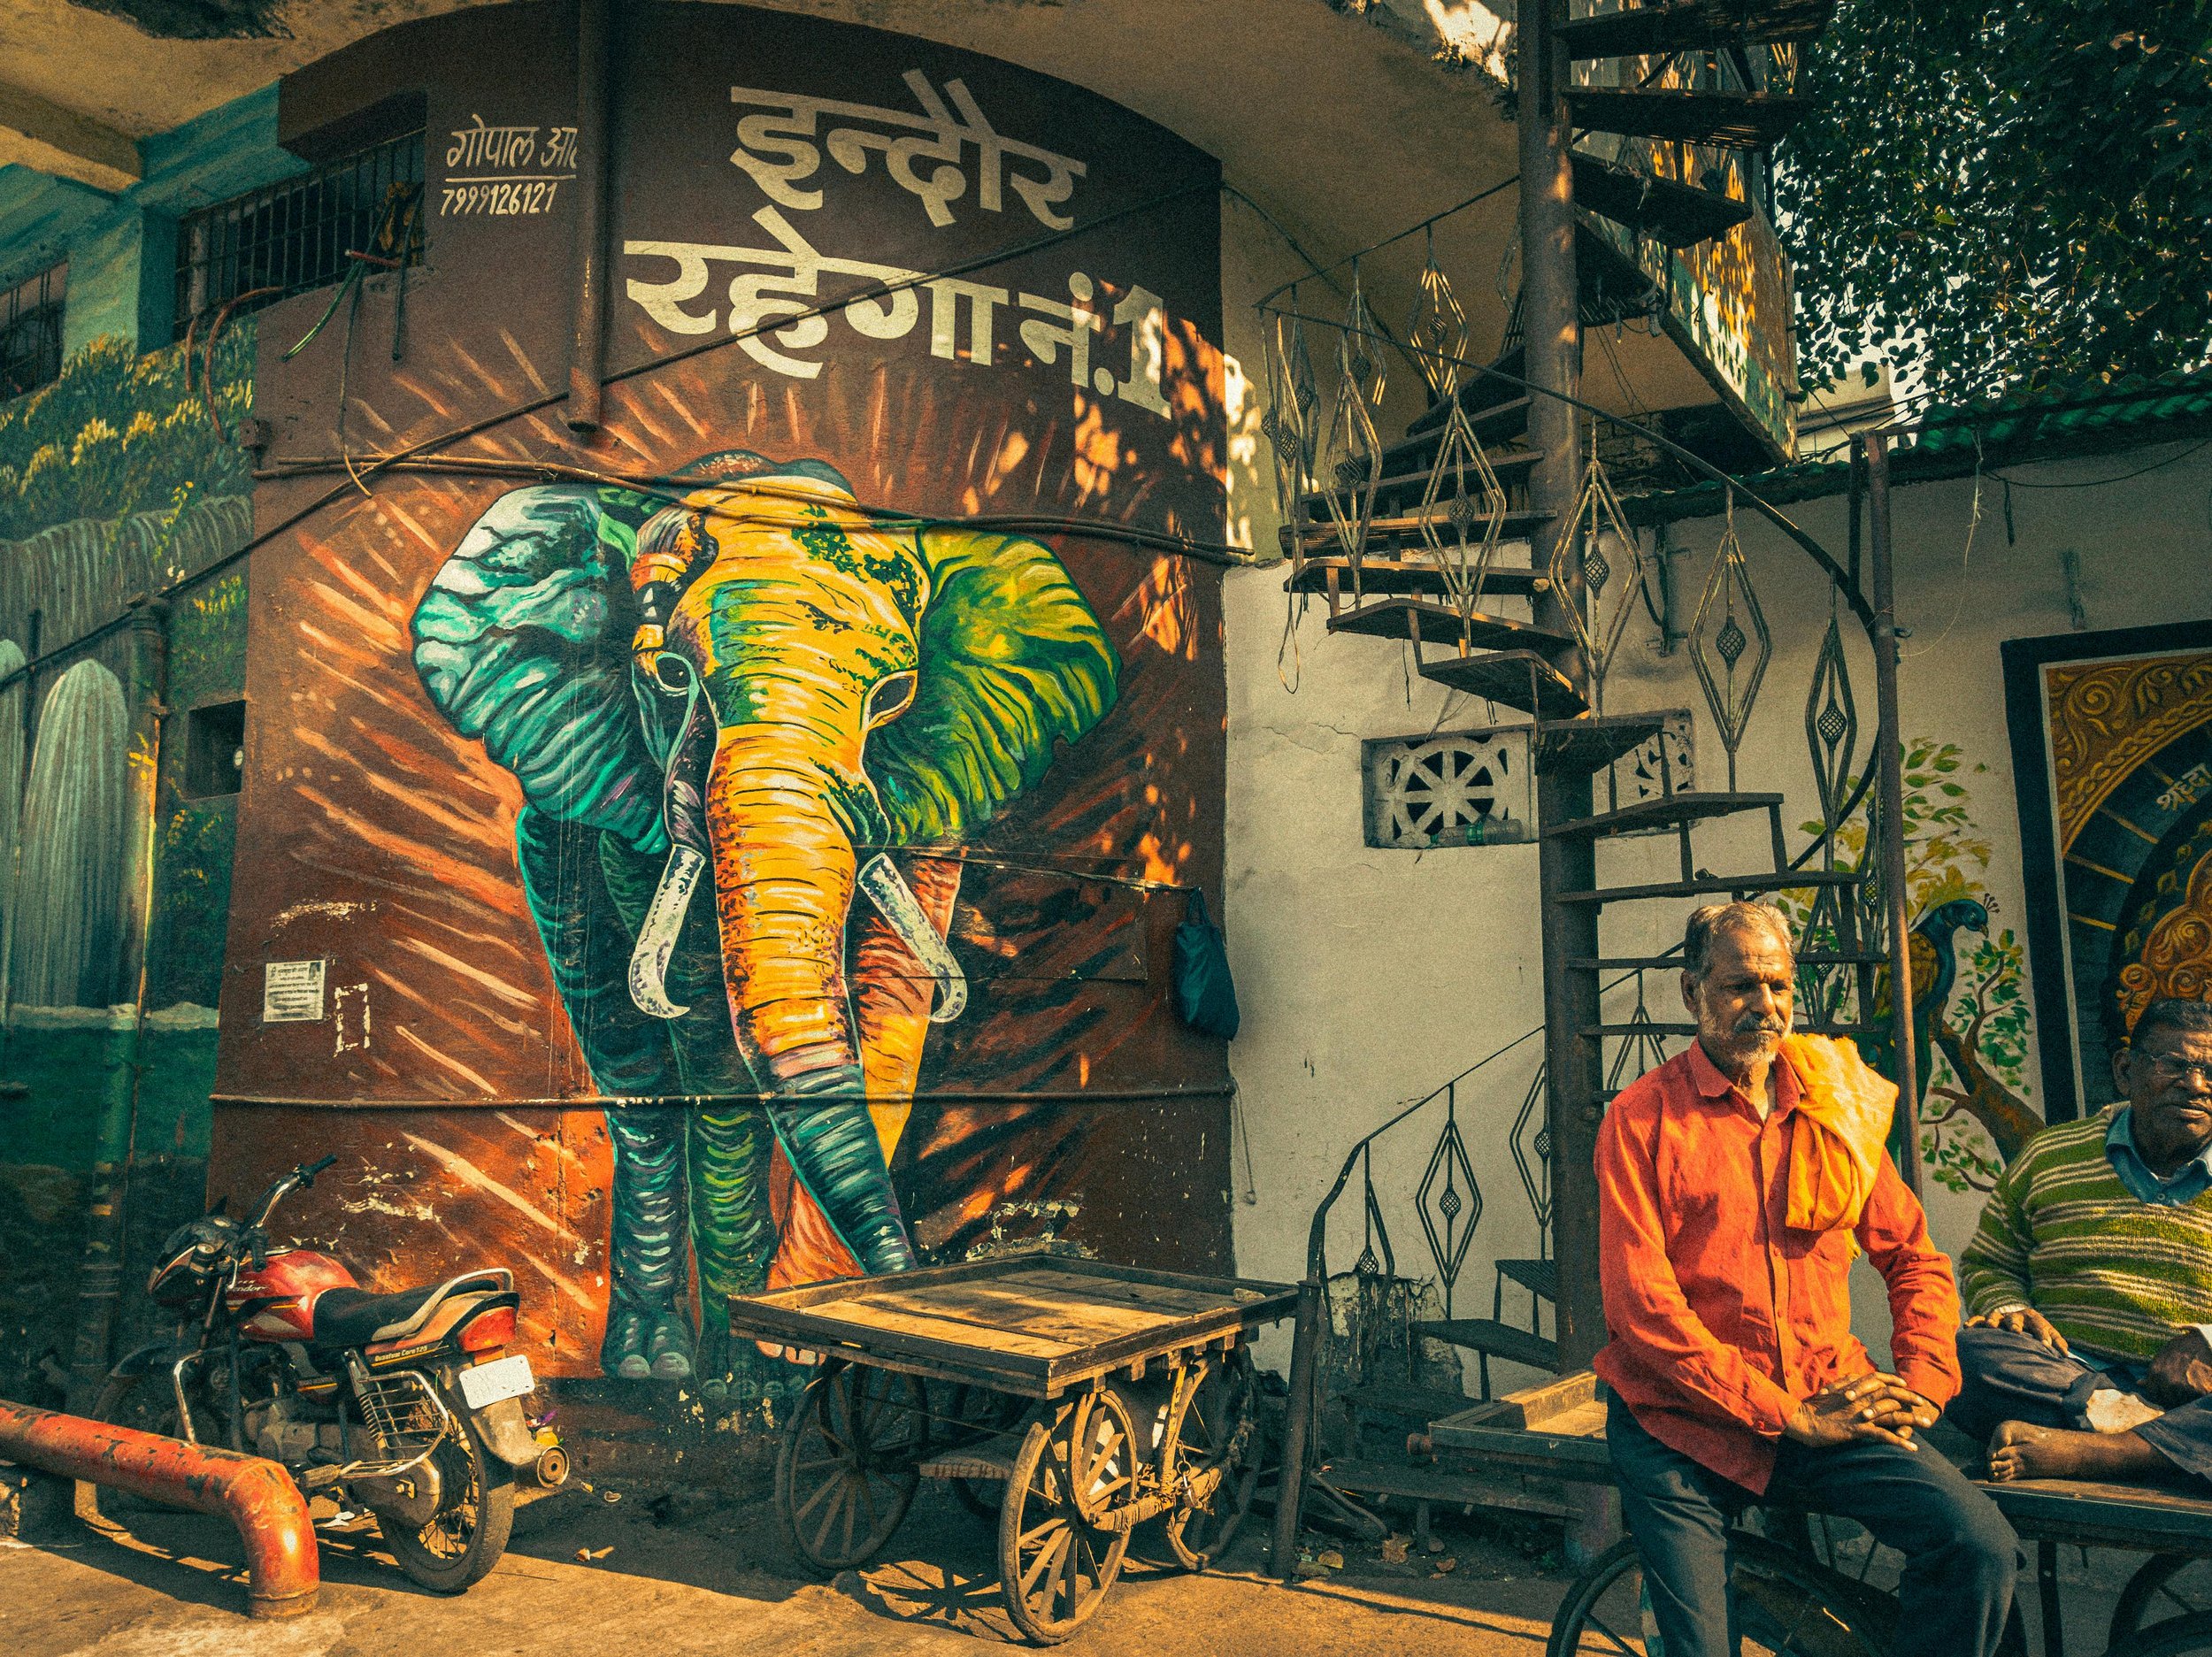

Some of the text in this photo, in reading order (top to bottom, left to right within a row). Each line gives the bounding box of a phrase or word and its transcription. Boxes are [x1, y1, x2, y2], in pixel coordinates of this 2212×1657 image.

[446, 113, 540, 168] गोपाल
[729, 68, 1087, 231] इन्दौर
[440, 182, 558, 216] 7999126121
[624, 204, 1009, 380] रहेगा
